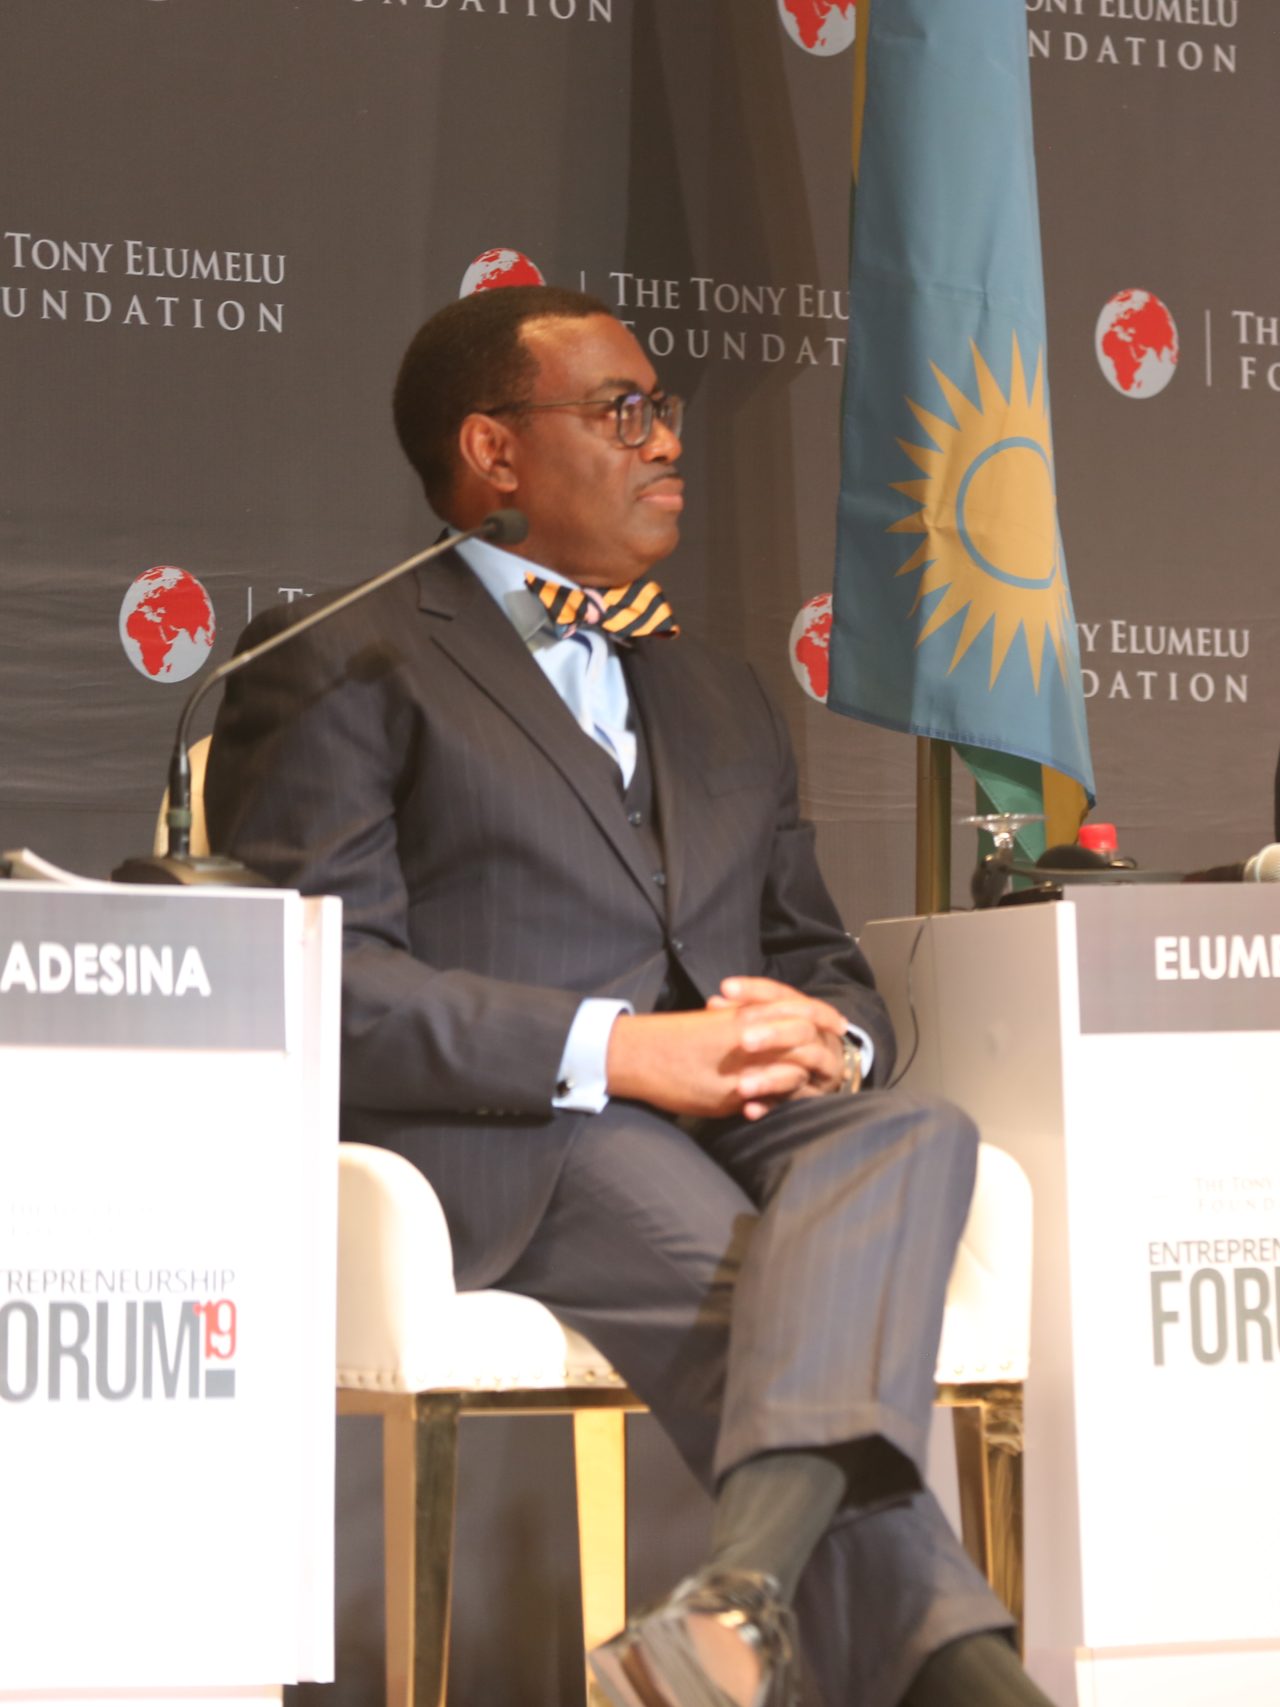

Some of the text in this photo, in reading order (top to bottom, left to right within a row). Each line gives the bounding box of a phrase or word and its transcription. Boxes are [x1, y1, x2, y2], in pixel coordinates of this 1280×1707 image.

[3, 231, 287, 286] TONY ELUMELU
[0, 286, 286, 334] UNDATION
[608, 271, 681, 310] THE
[689, 276, 787, 316] TONY
[619, 319, 847, 368] OUNDAT
[1110, 619, 1250, 659] ELUMELU
[0, 941, 212, 997] ADESINA
[0, 1269, 236, 1294] REPRENEURSHIP
